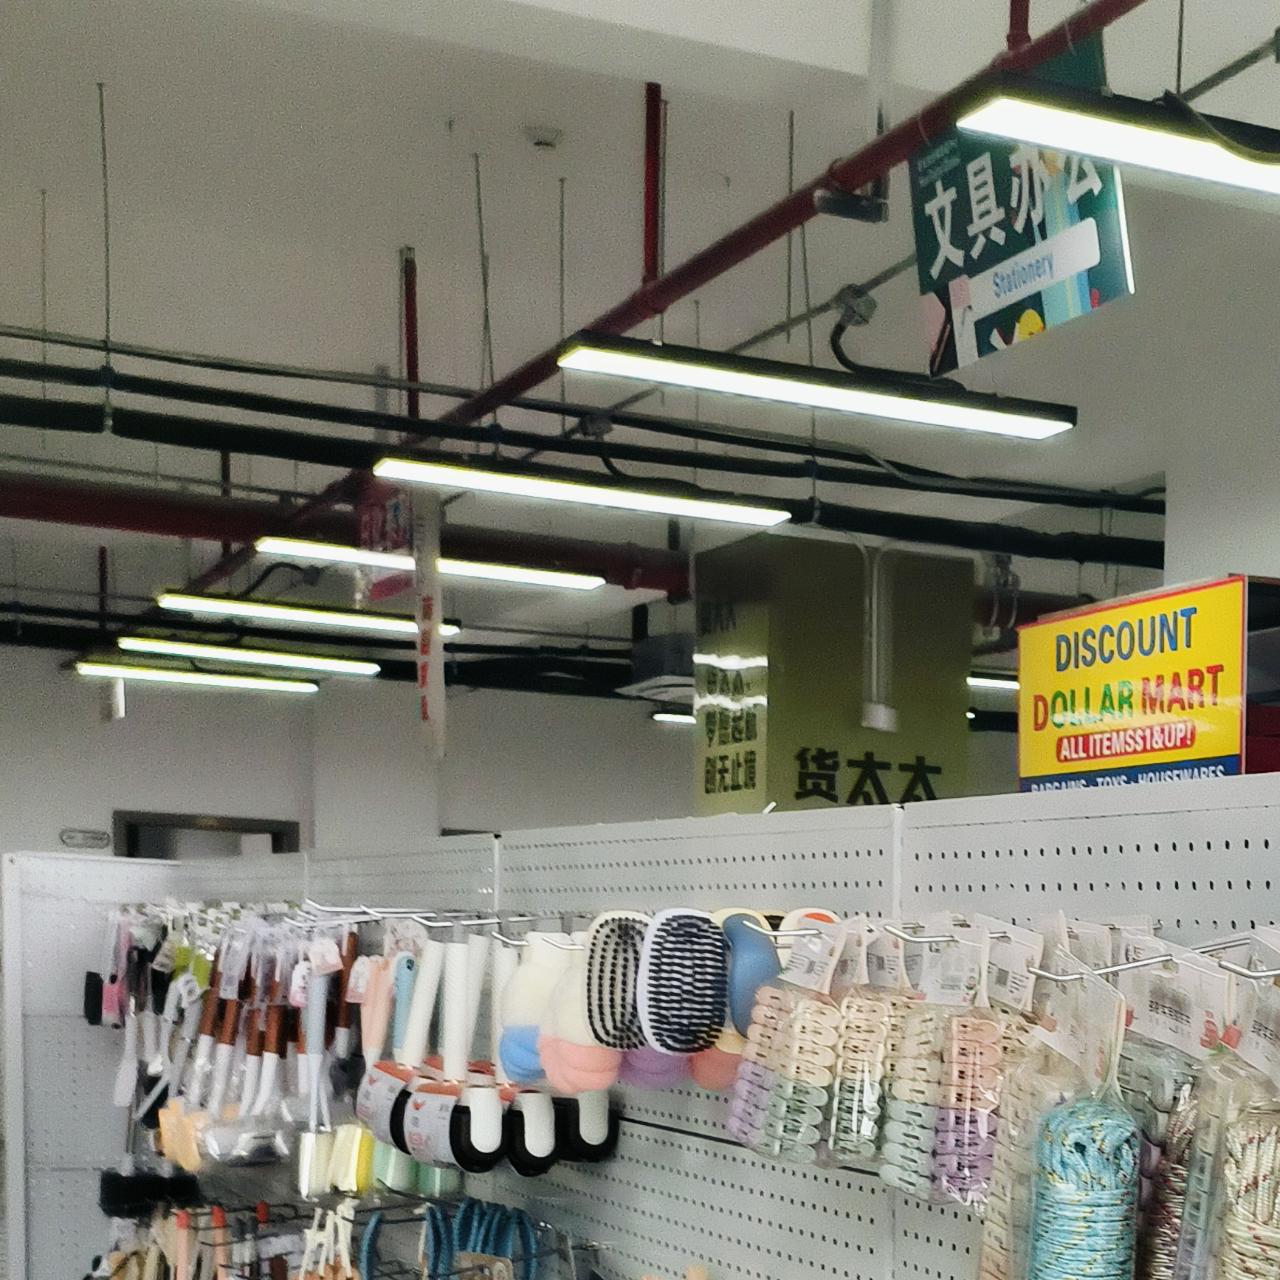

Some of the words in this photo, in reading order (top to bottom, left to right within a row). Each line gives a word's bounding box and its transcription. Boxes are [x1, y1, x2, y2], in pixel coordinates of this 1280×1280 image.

[993, 254, 1055, 299] Stationery
[1055, 607, 1198, 673] DISCOUNT
[1033, 680, 1135, 732] DOLLAR
[1141, 664, 1225, 717] MART
[795, 746, 943, 805] 货太太
[1060, 736, 1087, 760] ALL
